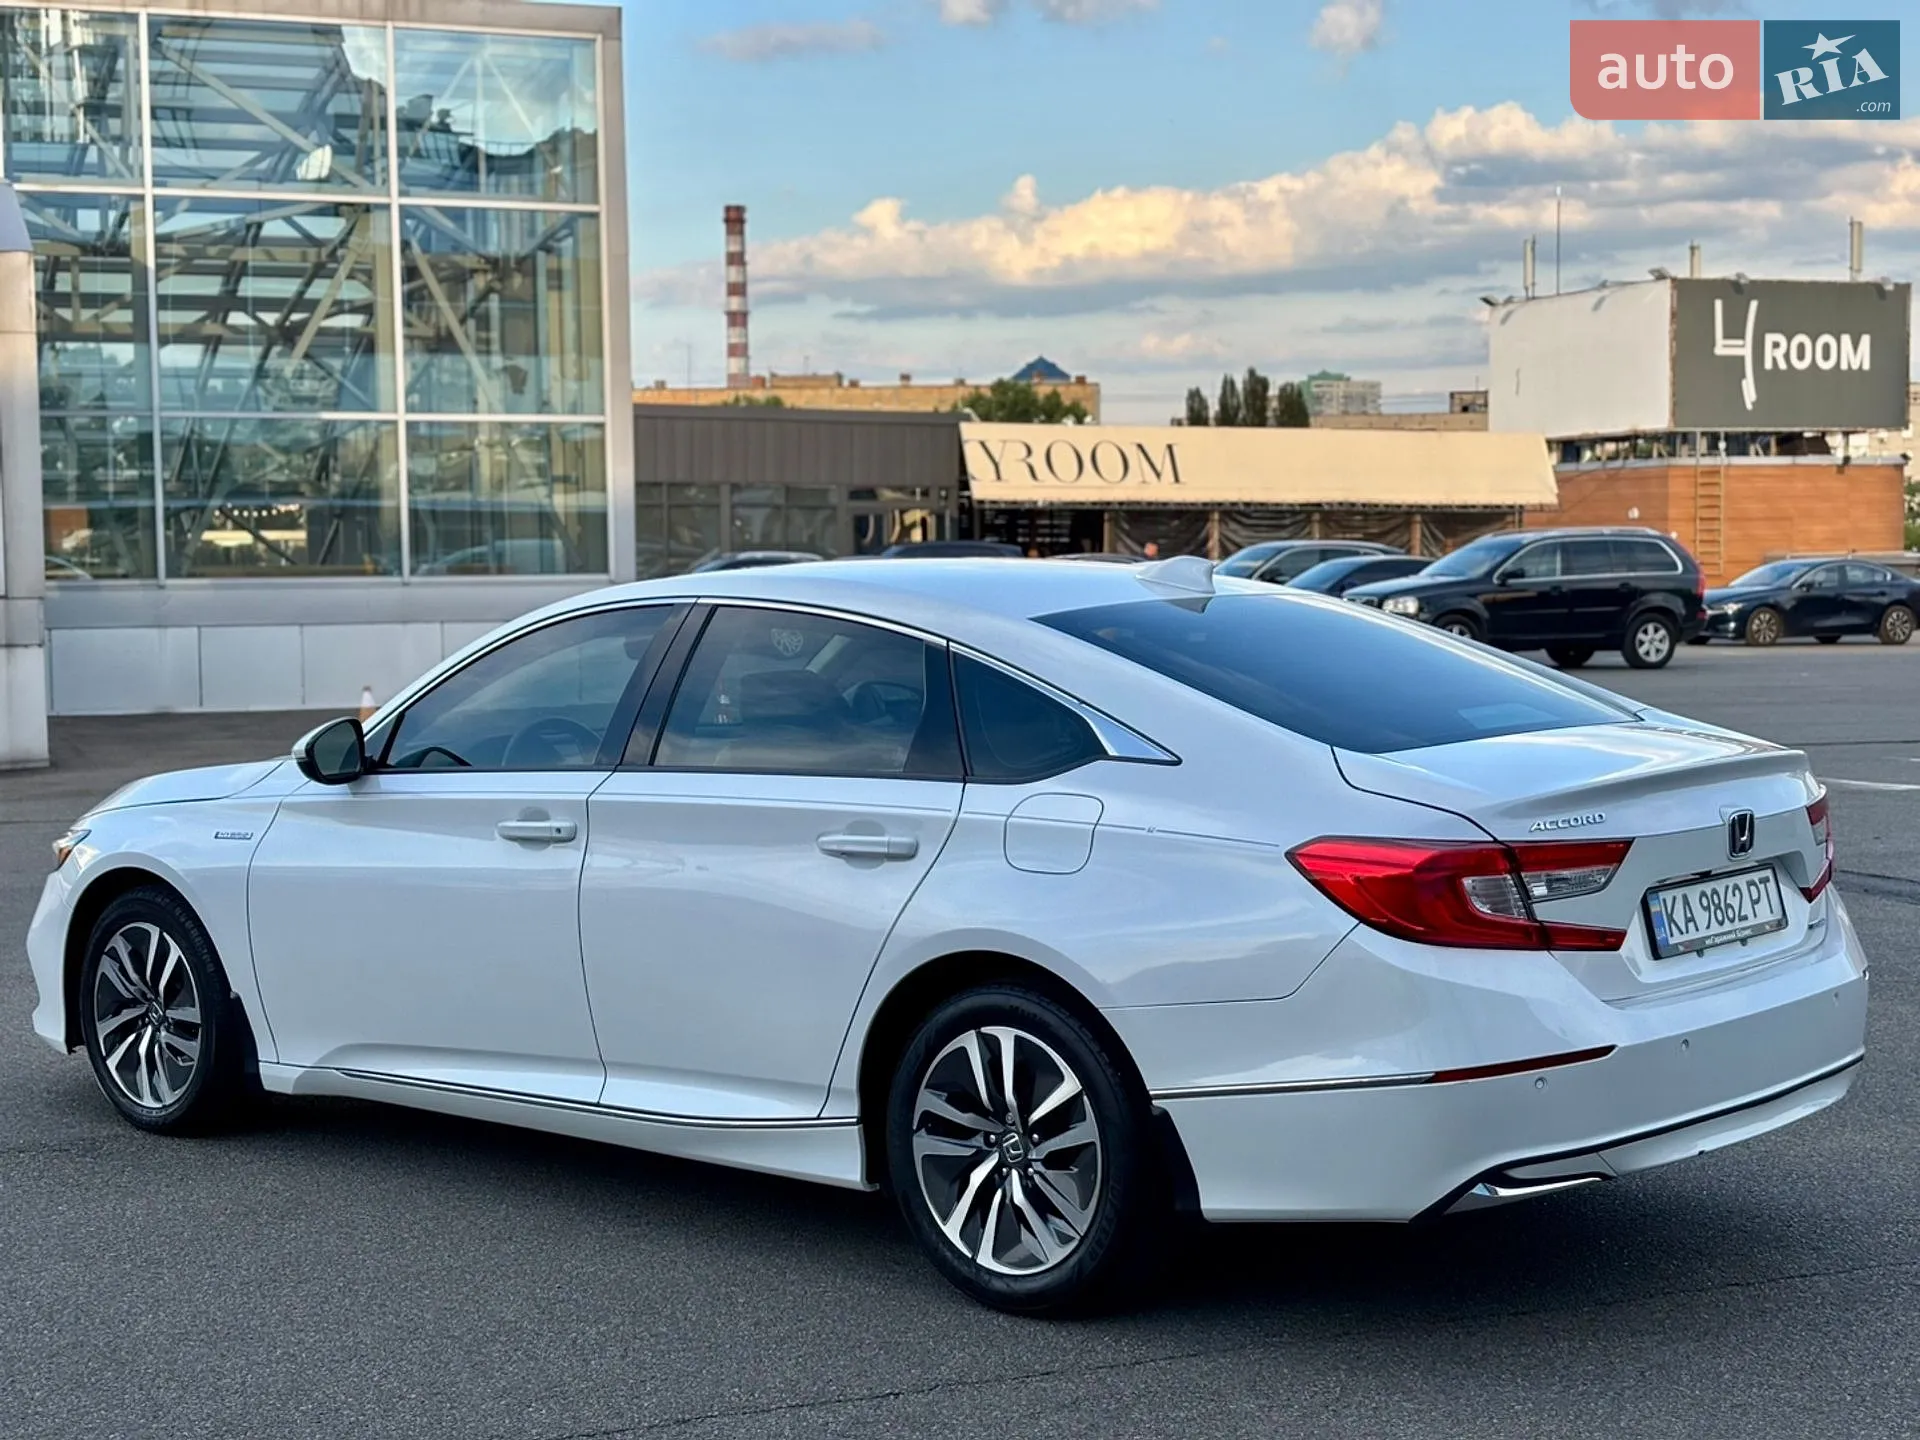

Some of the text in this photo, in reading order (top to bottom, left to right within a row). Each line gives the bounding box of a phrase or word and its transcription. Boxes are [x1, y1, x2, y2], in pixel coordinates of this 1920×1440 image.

[1764, 333, 1871, 370] ROOM
[963, 439, 1186, 485] YROOM
[1528, 812, 1606, 833] ACCORD
[1699, 883, 1748, 929] 9862
